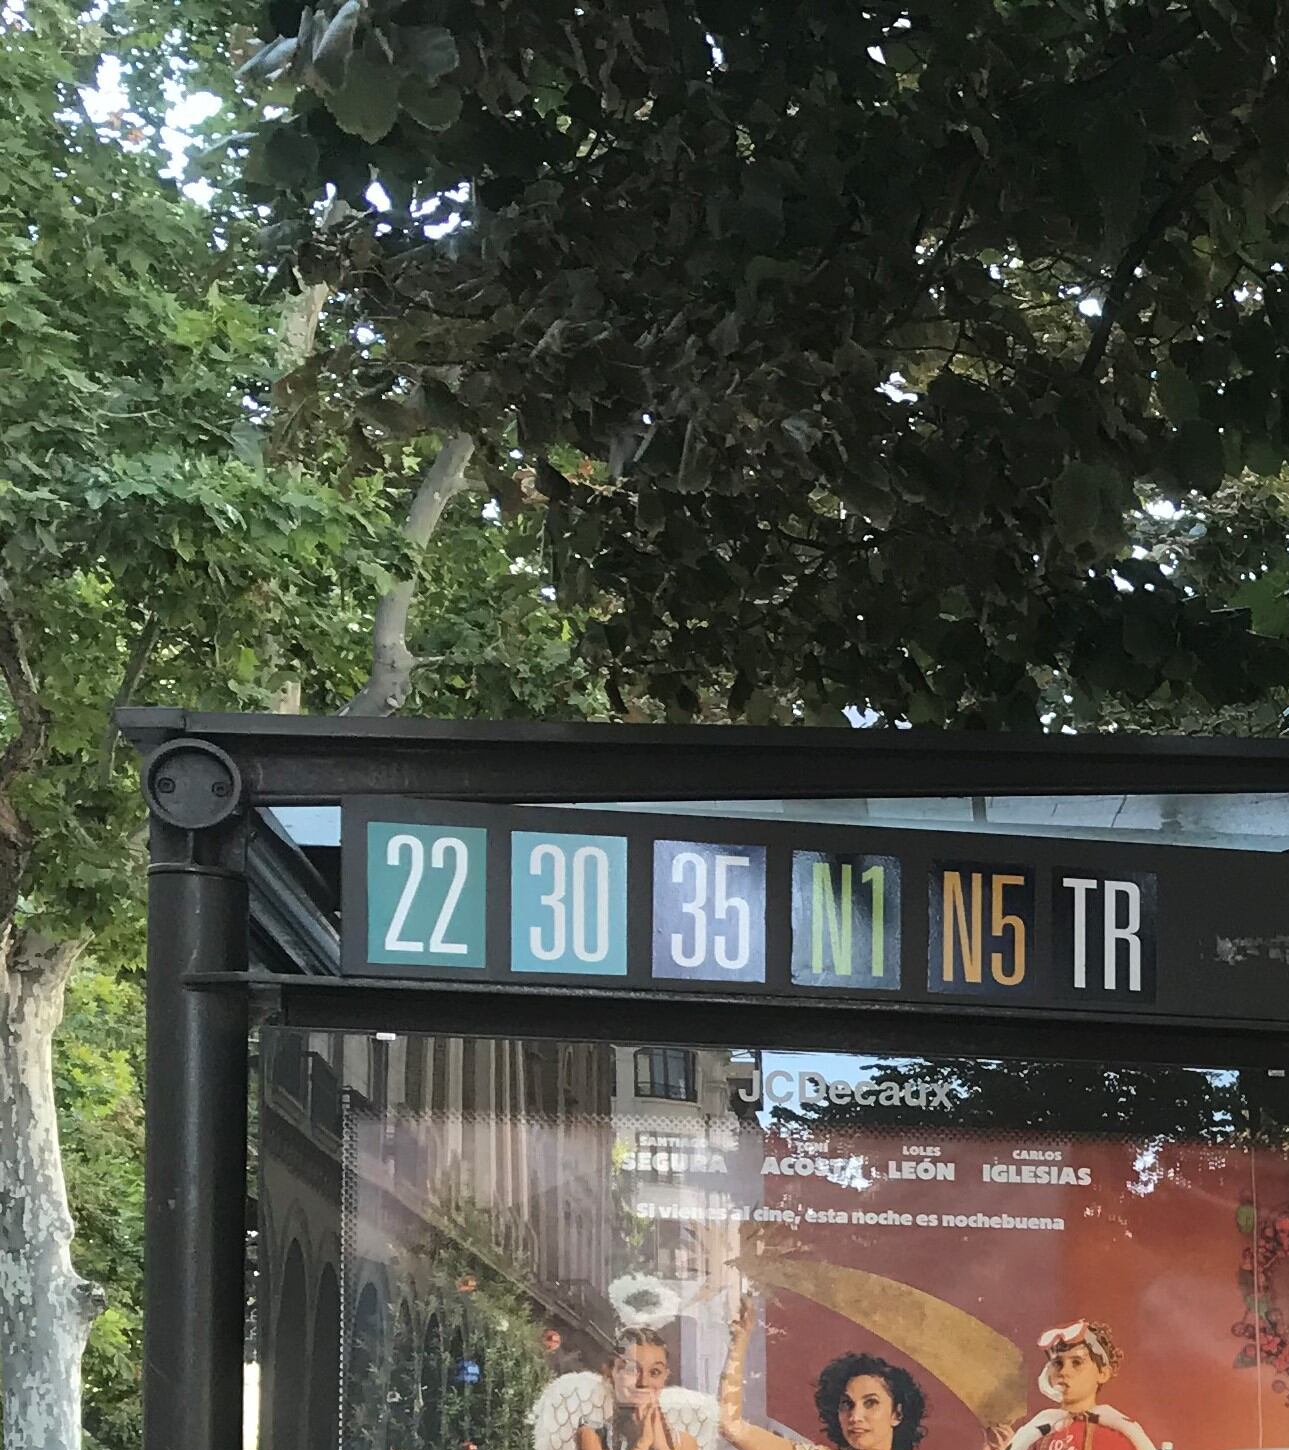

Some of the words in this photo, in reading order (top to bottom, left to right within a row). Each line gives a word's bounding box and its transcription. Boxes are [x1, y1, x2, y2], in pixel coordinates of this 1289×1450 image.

[384, 833, 470, 956] 22
[529, 843, 610, 963] 30
[670, 852, 751, 972] 35
[811, 861, 885, 978] N1
[943, 869, 1027, 987] N5
[1062, 876, 1141, 993] TR
[738, 1069, 953, 1108] JCDecaux
[620, 1151, 728, 1175] SEGURA
[902, 1146, 942, 1157] LOLES
[1012, 1150, 1062, 1162] CARLOS
[760, 1155, 863, 1178] ACOSTA
[888, 1157, 956, 1181] LEÓN
[982, 1164, 1092, 1186] IGLESIAS
[636, 1202, 655, 1218] Si
[658, 1203, 727, 1221] vienes
[730, 1205, 749, 1221] al
[752, 1205, 801, 1224] cine,
[852, 1209, 913, 1226] noche
[916, 1214, 938, 1227] es
[942, 1213, 1065, 1231] nochebuena
